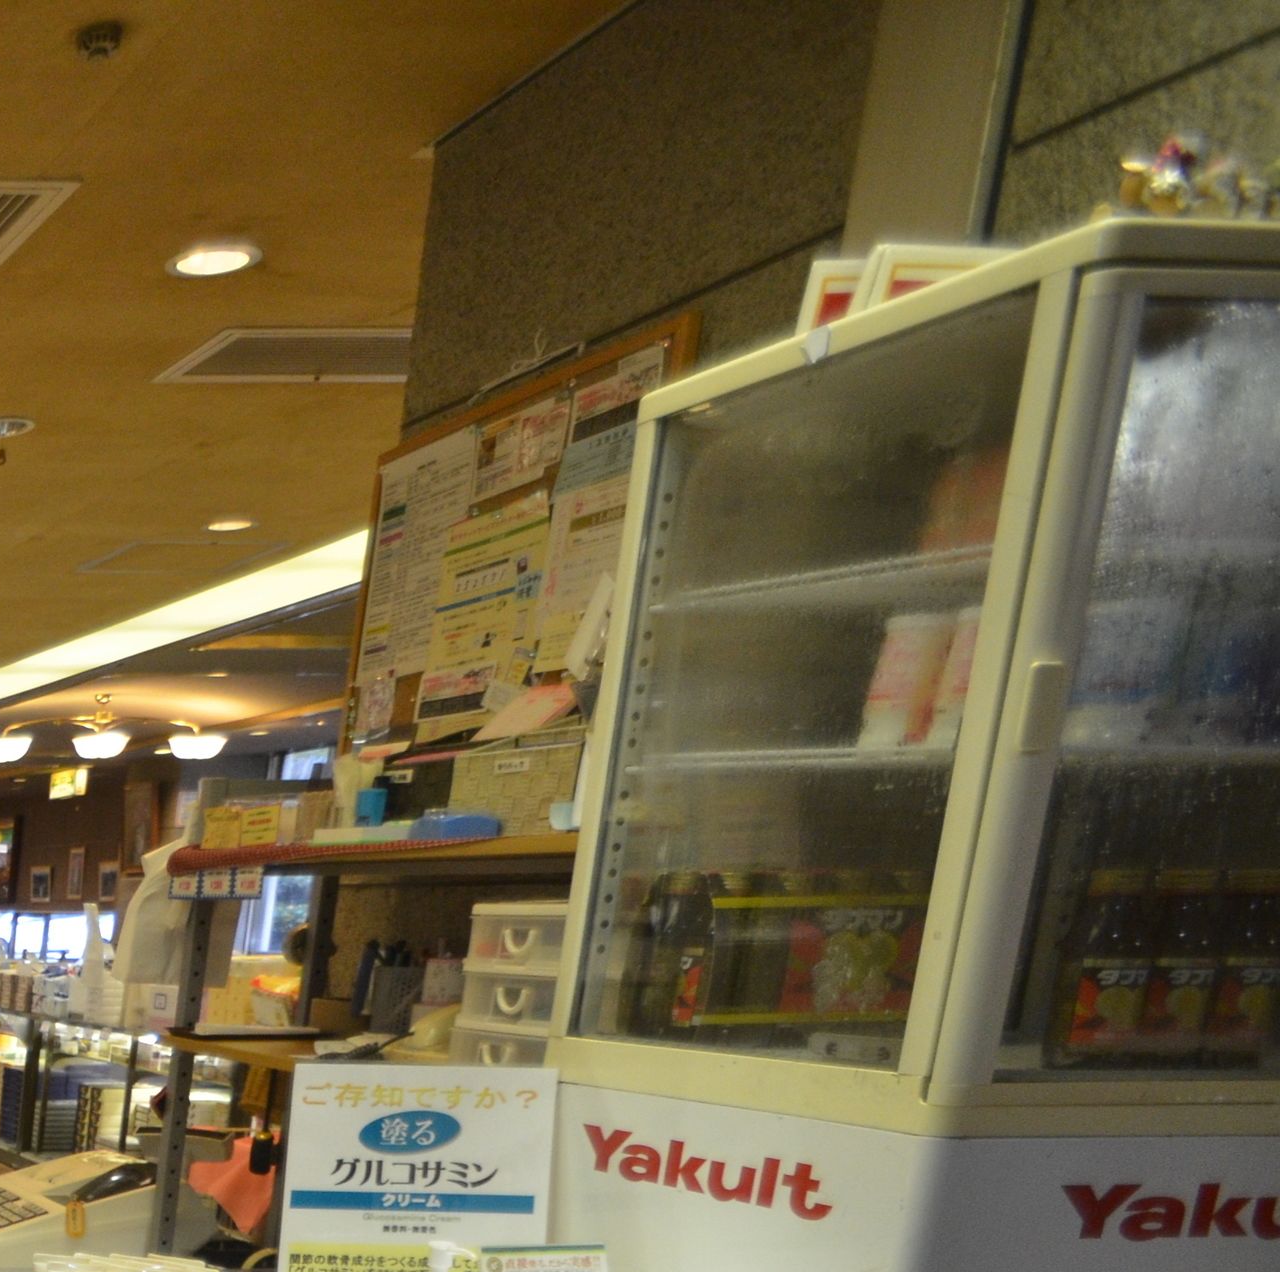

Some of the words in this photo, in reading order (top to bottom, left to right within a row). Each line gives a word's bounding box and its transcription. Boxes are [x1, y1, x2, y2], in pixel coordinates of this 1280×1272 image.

[378, 1116, 435, 1148] 塗る
[331, 1156, 498, 1190] グルコサミン
[583, 1123, 833, 1221] Yakult
[381, 1193, 441, 1208] クリーム
